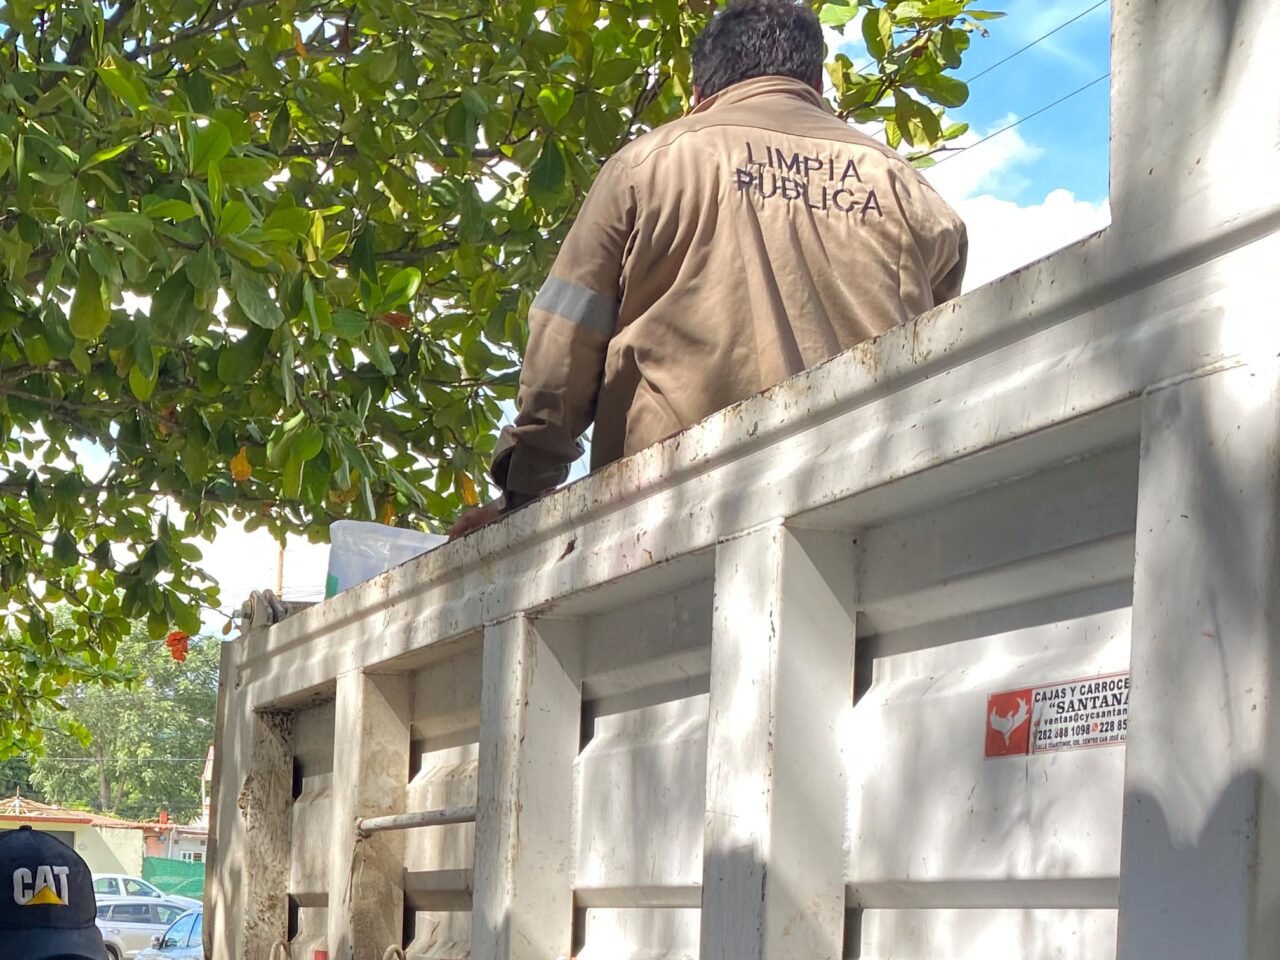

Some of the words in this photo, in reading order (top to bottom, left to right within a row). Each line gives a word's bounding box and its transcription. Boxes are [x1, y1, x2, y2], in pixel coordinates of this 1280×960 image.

[745, 141, 862, 183] LIMPIA
[736, 163, 883, 217] PUBLICA
[1034, 687, 1067, 703] CAJAS
[1070, 686, 1076, 697] Y
[1038, 729, 1052, 740] 282
[1071, 724, 1091, 737] 1098
[1100, 721, 1114, 733] 228
[13, 865, 70, 906] CAT
